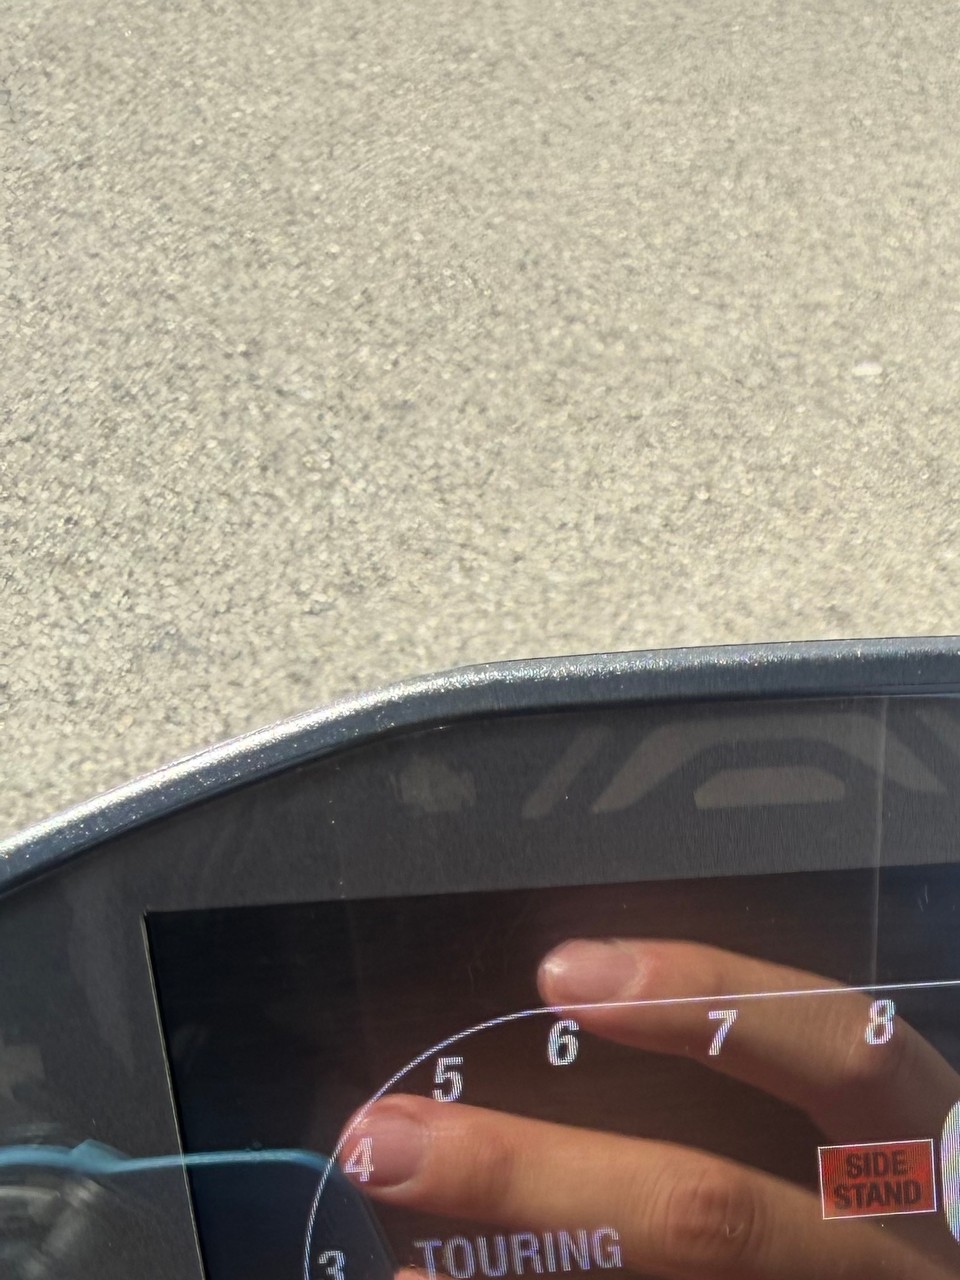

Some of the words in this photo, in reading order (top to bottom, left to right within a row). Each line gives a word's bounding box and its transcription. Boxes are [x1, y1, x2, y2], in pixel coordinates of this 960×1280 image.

[546, 1020, 579, 1066] 6
[707, 1009, 738, 1055] 7
[865, 999, 895, 1044] 8
[433, 1057, 464, 1102] 5
[344, 1137, 374, 1182] 4
[845, 1150, 909, 1179] SIDE
[834, 1181, 921, 1210] STAND
[414, 1227, 622, 1280] TOURING
